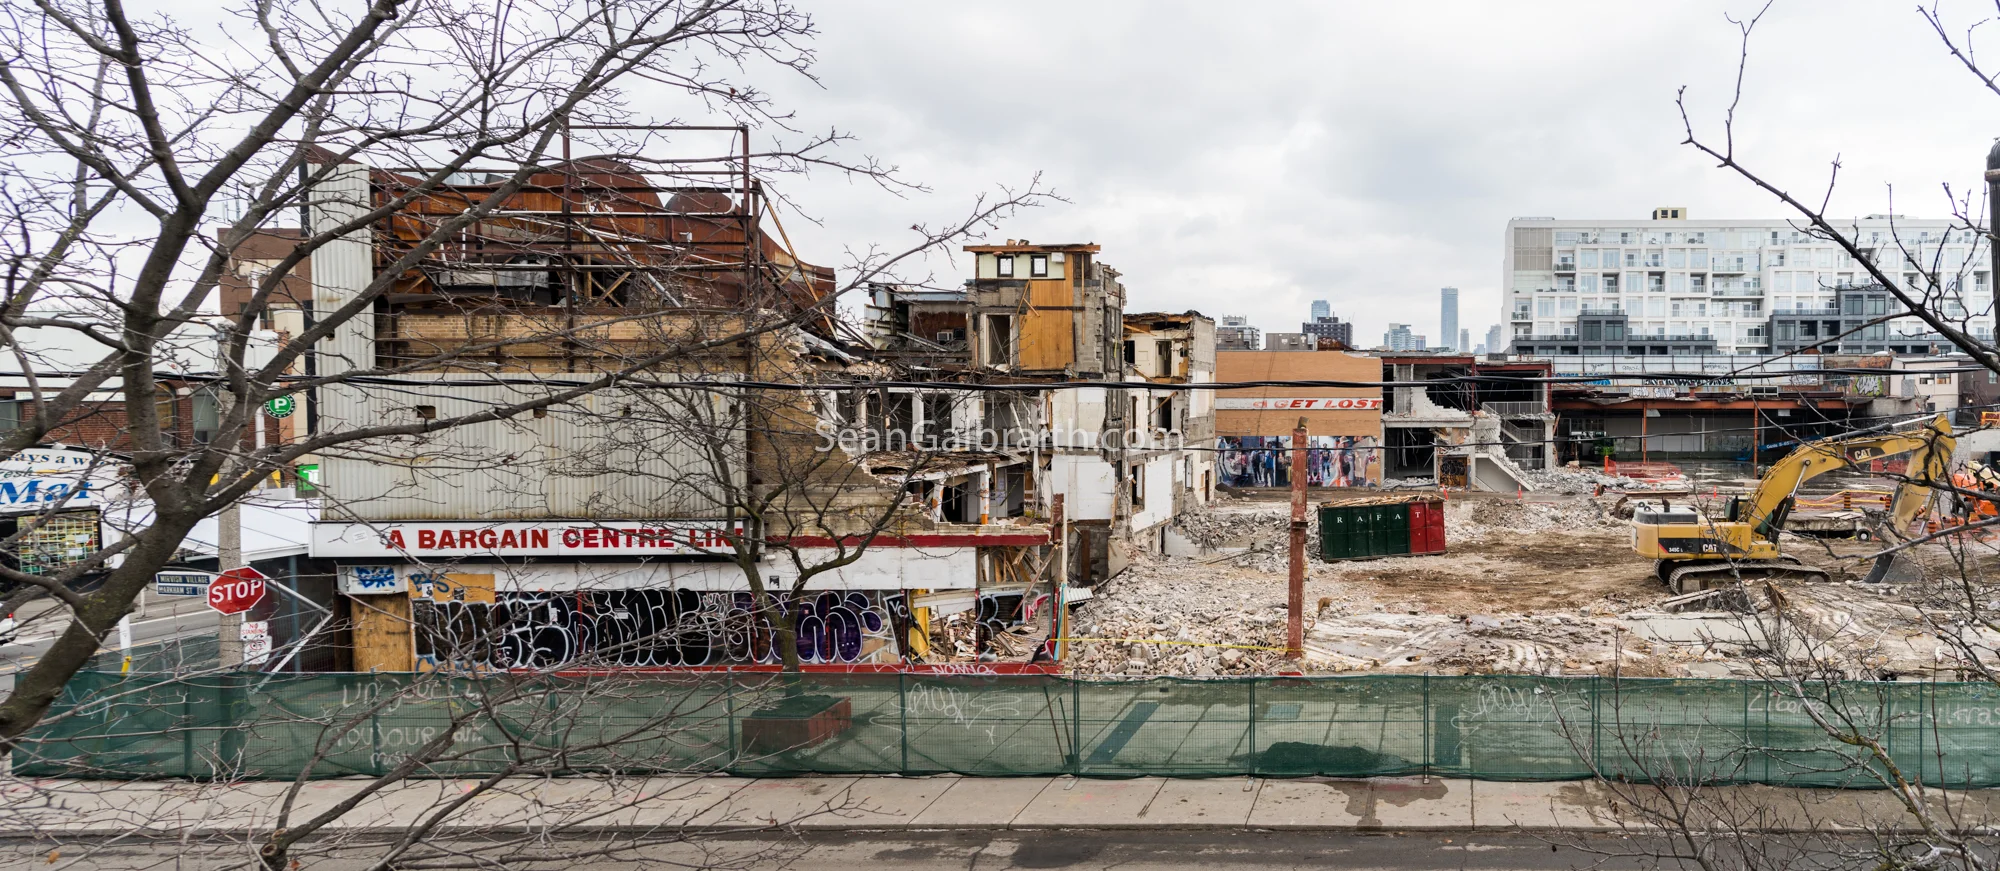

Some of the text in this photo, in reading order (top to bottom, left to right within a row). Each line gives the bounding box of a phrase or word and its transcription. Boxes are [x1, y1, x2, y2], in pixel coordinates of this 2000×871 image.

[1274, 400, 1318, 409] GET
[1324, 399, 1384, 409] LOST
[1854, 447, 1872, 460] CAT
[386, 530, 406, 549] A
[418, 529, 549, 549] BARGAIN
[562, 528, 675, 549] CENTRE
[1702, 543, 1718, 553] CAT
[185, 575, 209, 584] VILLAGE
[212, 580, 261, 603] STOP
